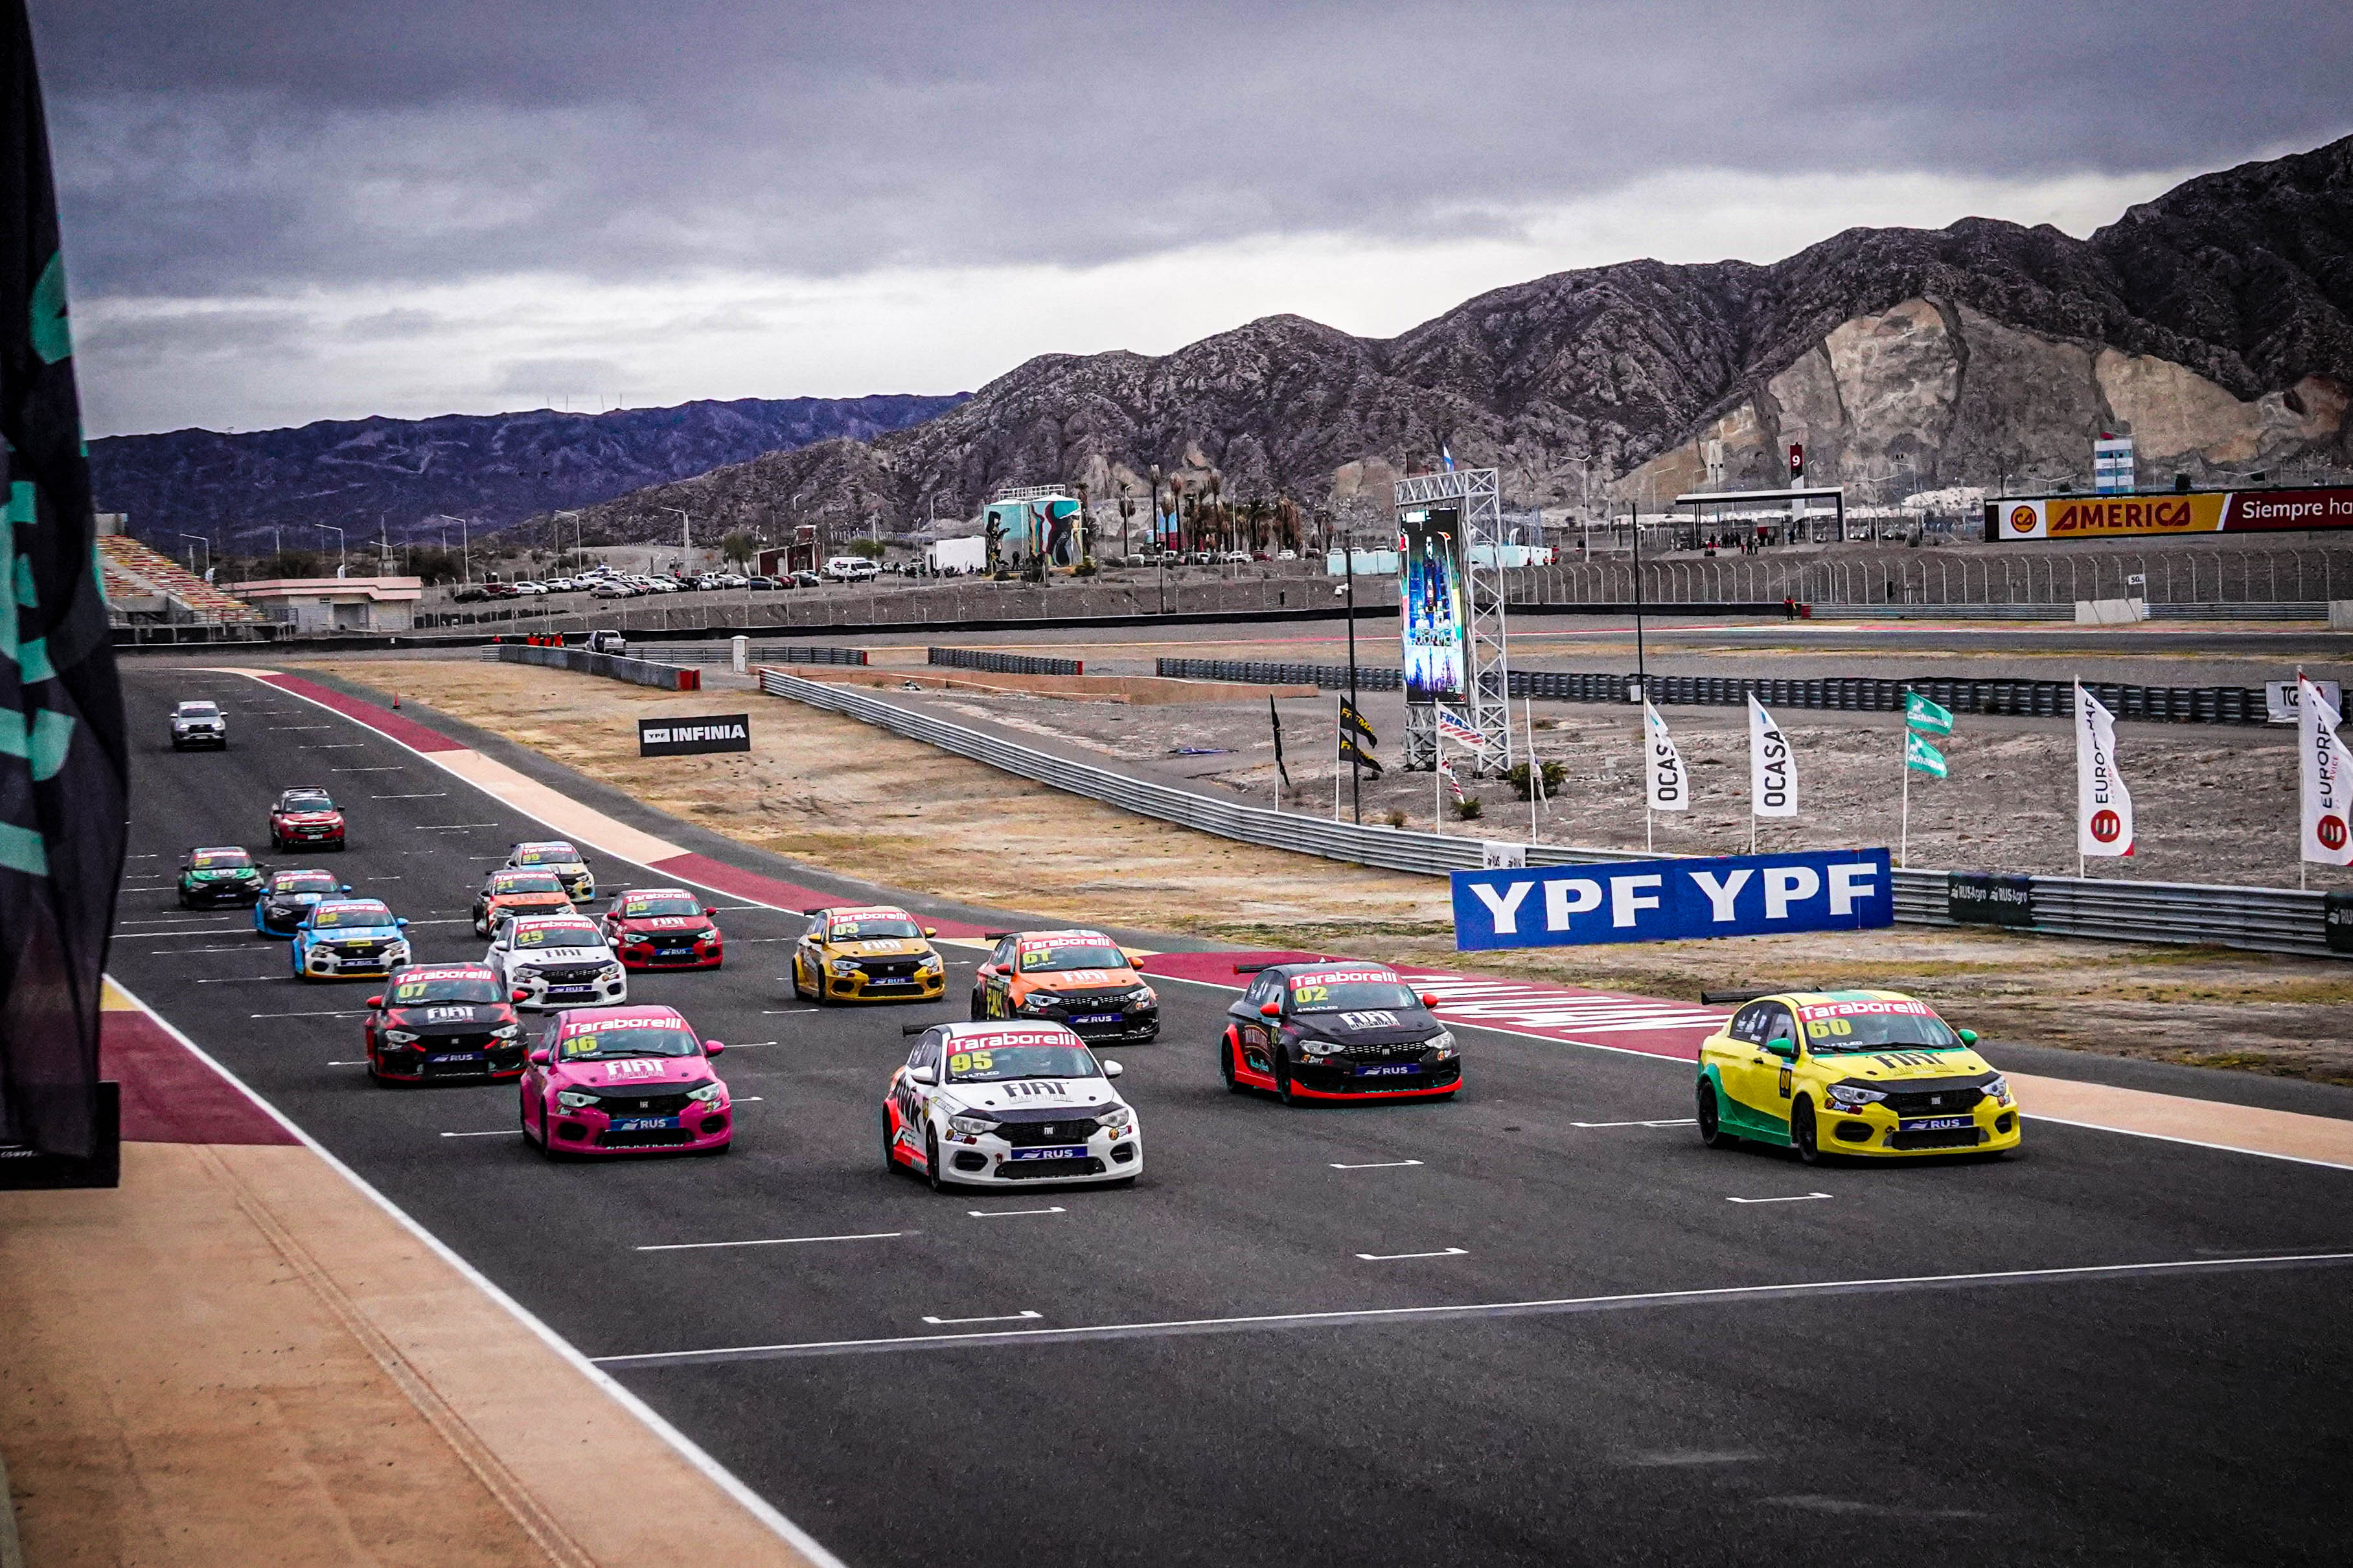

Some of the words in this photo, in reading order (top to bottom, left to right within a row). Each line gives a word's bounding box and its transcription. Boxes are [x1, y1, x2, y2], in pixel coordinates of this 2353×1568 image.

[1792, 455, 1800, 466] 9
[2052, 501, 2190, 530] AMERICA
[2242, 501, 2323, 521] Siempre
[672, 724, 746, 742] INFINIA
[1764, 731, 1786, 807] OCASA
[1468, 874, 1661, 934] YPF
[1688, 863, 1878, 922] YPF
[519, 921, 593, 931] Taraborelli
[831, 913, 907, 924] Taraborelli
[1022, 938, 1110, 951] Taraborelli
[396, 971, 492, 984] Taraborelli
[1061, 971, 1109, 983] FIAT
[1291, 971, 1398, 987] Taraborelli
[398, 983, 427, 998] 07
[1296, 986, 1328, 1003] 02
[427, 1006, 476, 1018] FIAT
[1339, 1010, 1397, 1025] FIAT
[1798, 1001, 1927, 1020] Taraborelli
[566, 1017, 681, 1035] Taraborelli
[1806, 1019, 1852, 1038] 60
[563, 1035, 597, 1054] 16
[950, 1033, 1076, 1052] Taraborelli
[605, 1059, 665, 1075] FIAT
[950, 1051, 993, 1073] 95
[1874, 1053, 1945, 1069] FIAT
[1002, 1082, 1068, 1097] FIAT
[640, 1119, 667, 1129] RUS
[1931, 1119, 1960, 1128] RUS
[1042, 1149, 1073, 1159] RUS
